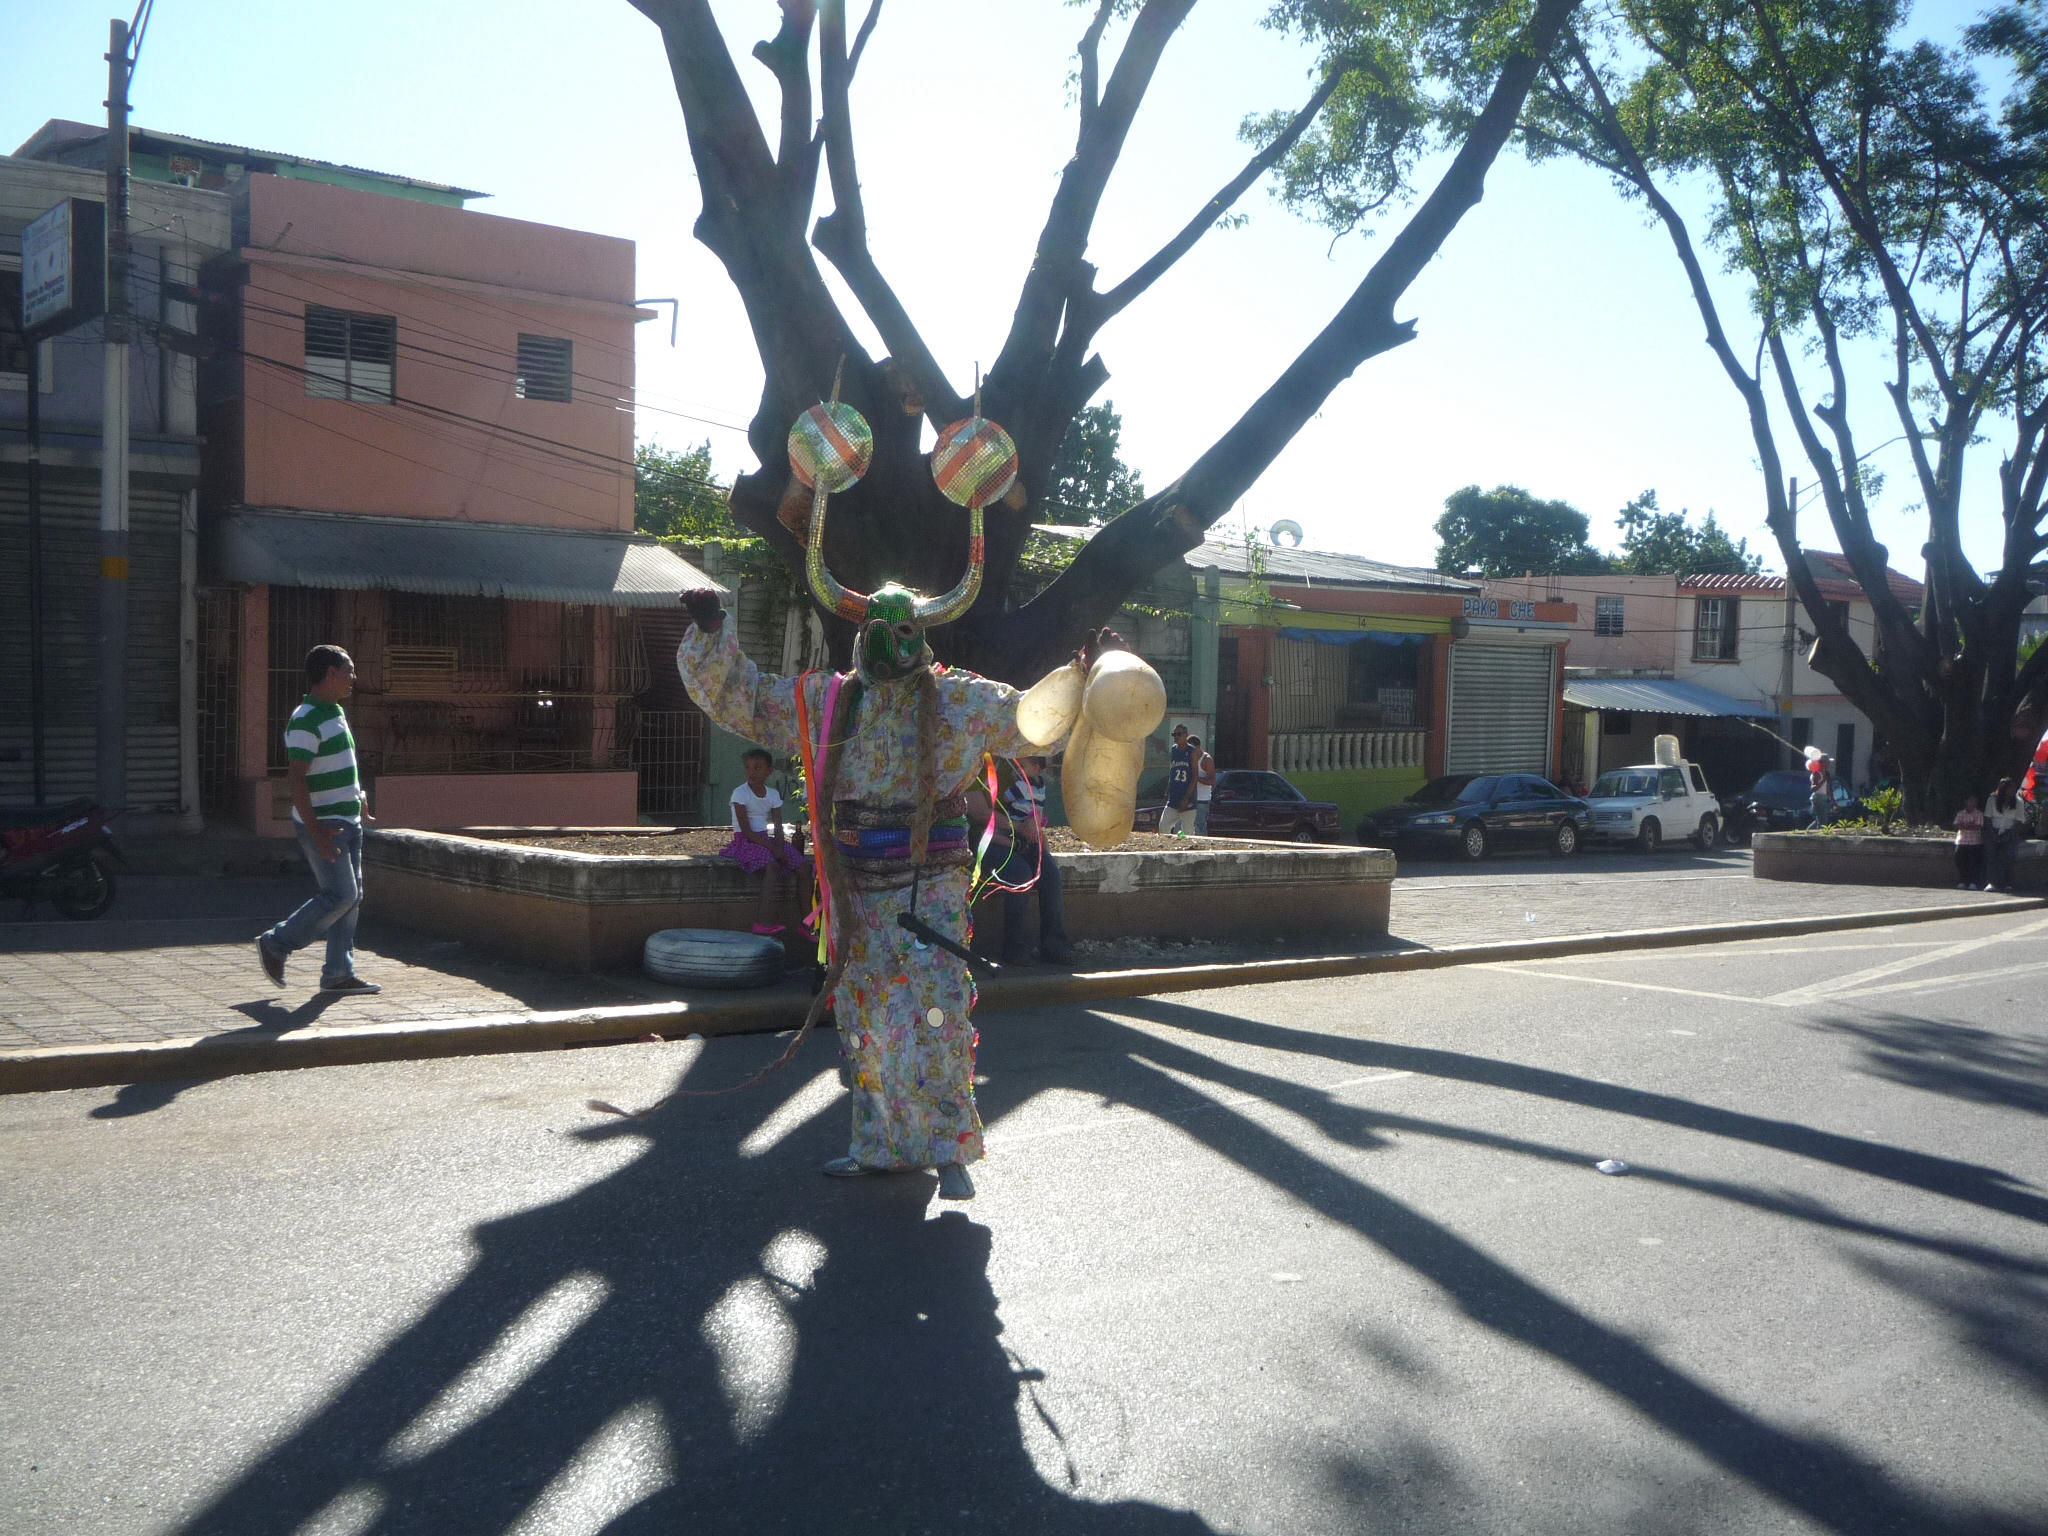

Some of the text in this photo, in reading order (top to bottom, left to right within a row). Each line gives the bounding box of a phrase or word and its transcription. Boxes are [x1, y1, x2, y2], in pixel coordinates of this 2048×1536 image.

[1463, 598, 1536, 619] PAKA CHE
[1174, 769, 1187, 782] 23
